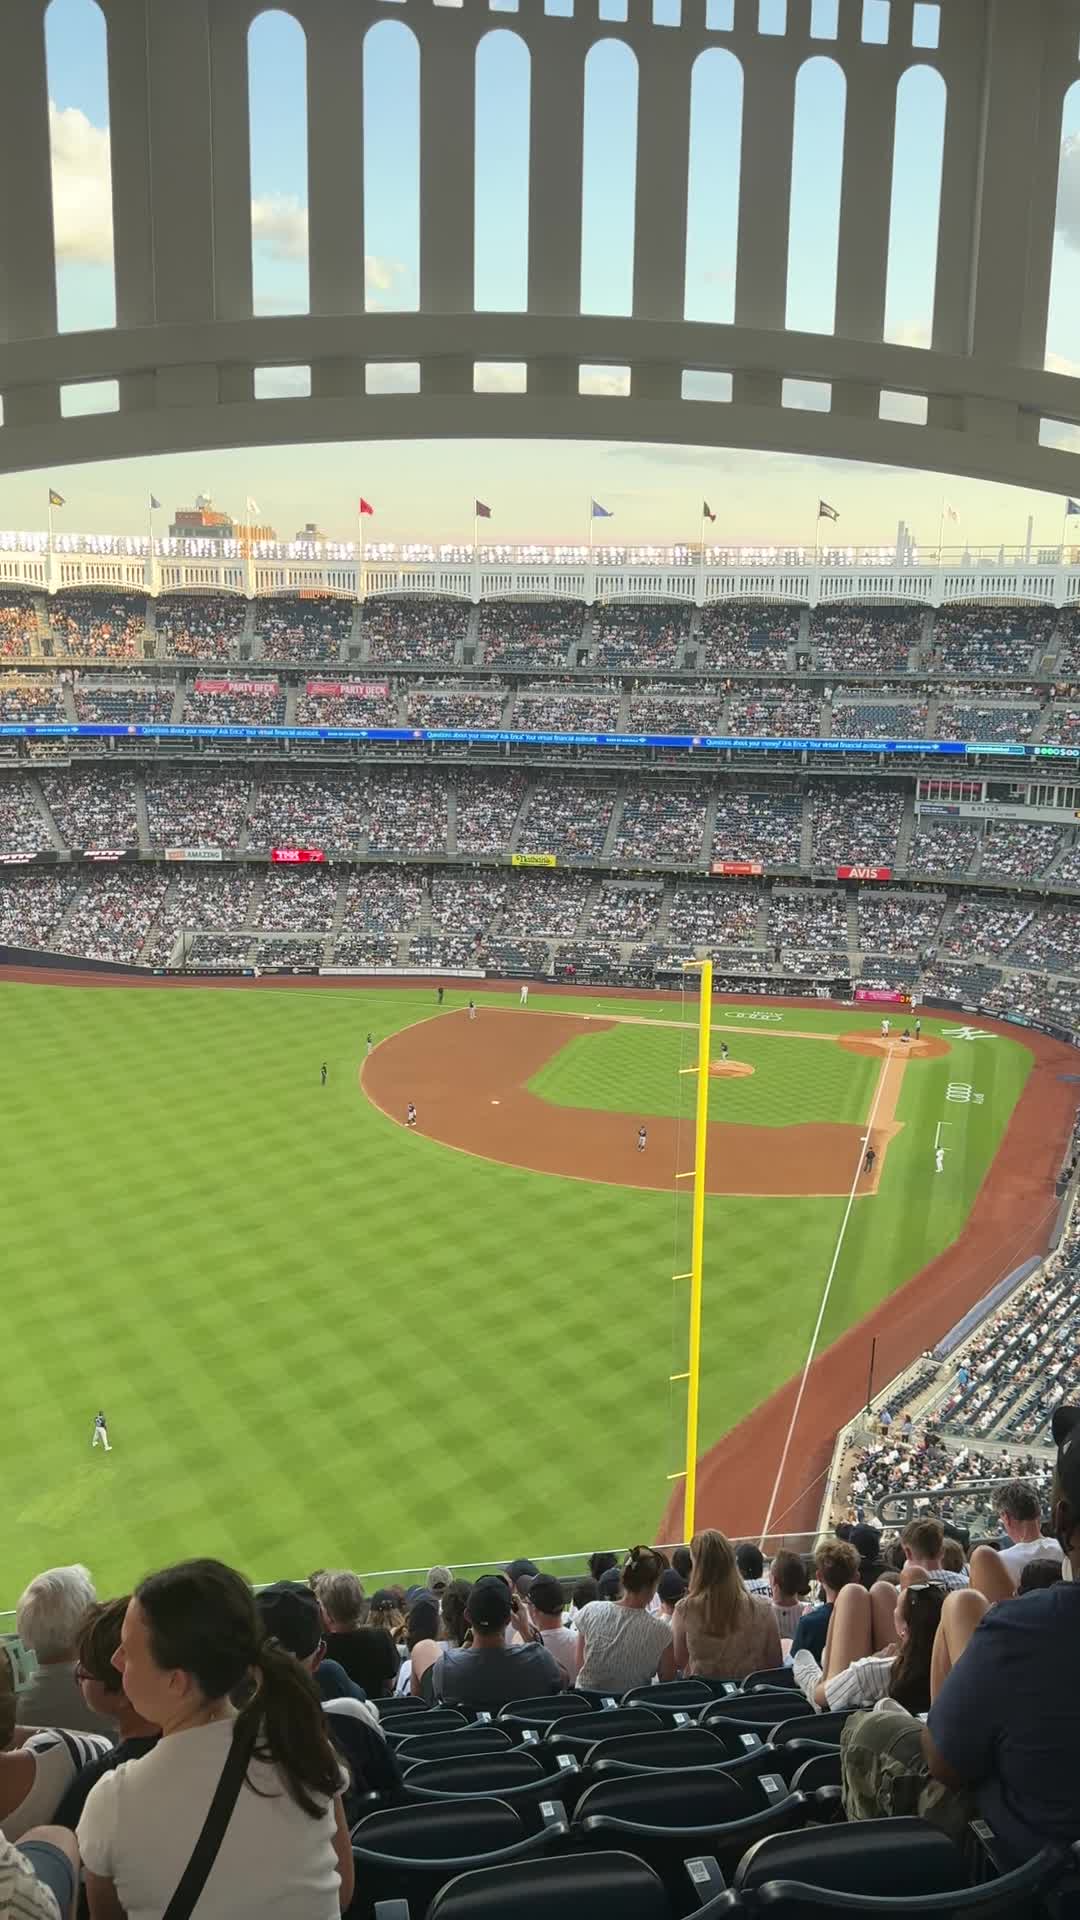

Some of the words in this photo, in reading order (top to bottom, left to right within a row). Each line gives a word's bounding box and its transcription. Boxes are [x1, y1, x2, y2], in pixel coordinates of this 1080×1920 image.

[229, 683, 254, 693] PARTY
[255, 684, 276, 694] DECK
[340, 685, 365, 694] PARTY
[367, 686, 386, 695] DECK
[186, 728, 196, 736] your
[468, 733, 479, 741] your
[848, 868, 878, 878] AVIS
